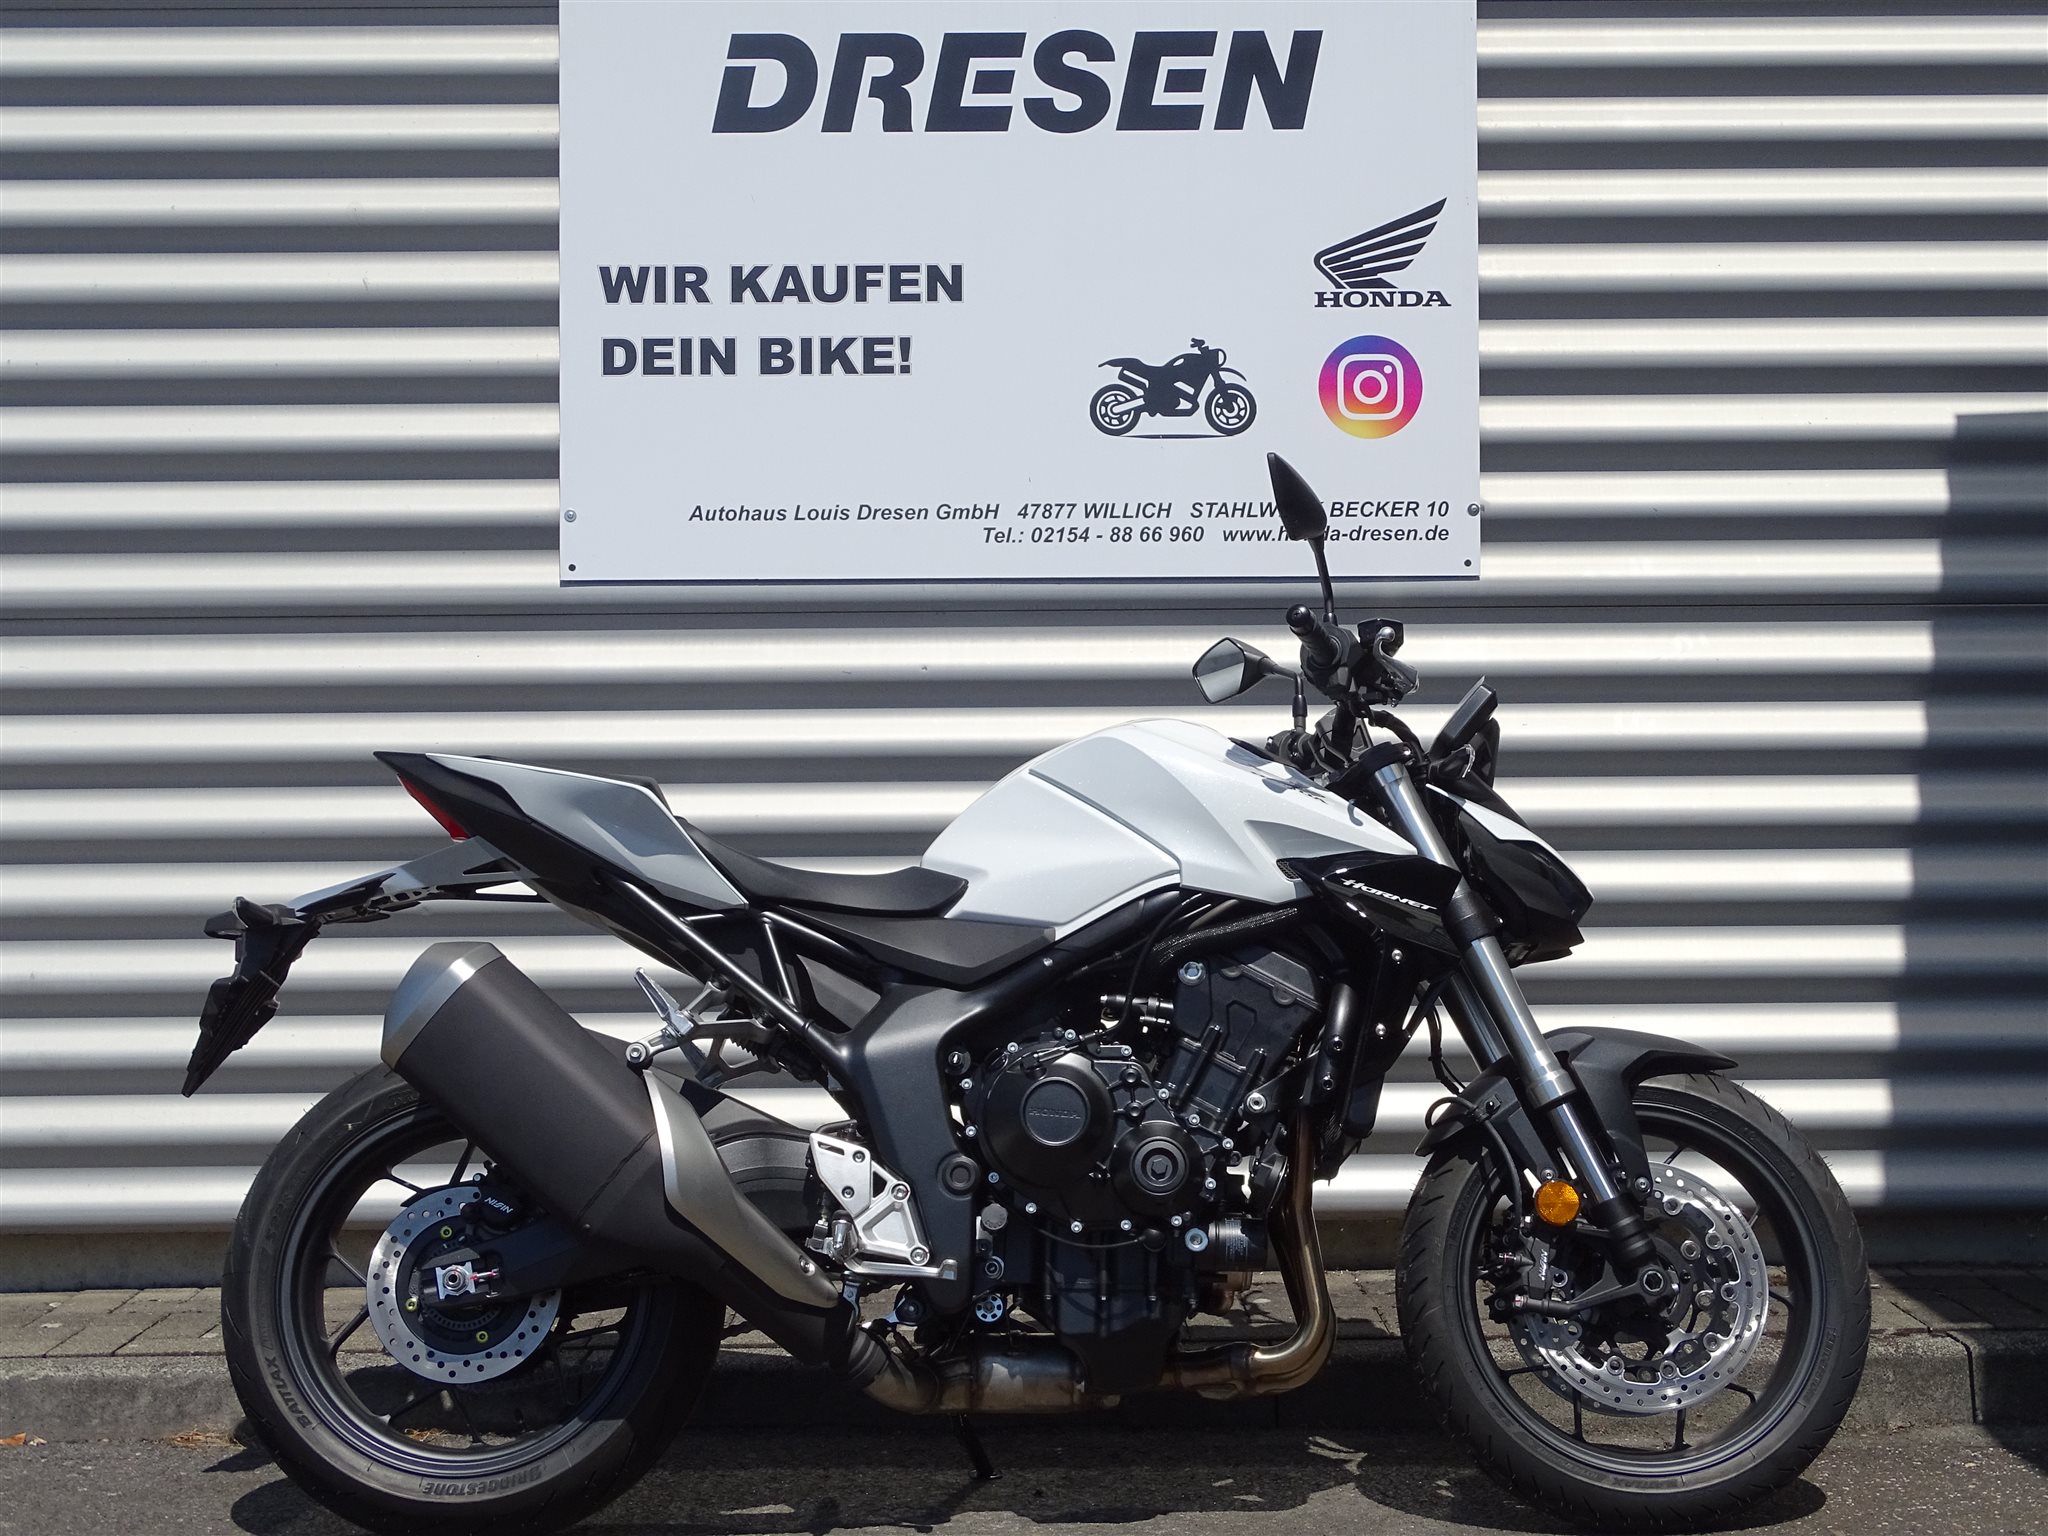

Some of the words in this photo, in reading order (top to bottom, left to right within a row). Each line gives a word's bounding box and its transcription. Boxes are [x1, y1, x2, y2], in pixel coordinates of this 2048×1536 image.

[712, 30, 1324, 134] DRESEN
[598, 265, 711, 304] WIR
[729, 264, 964, 304] KAUFEN
[1314, 290, 1452, 308] HONDA
[601, 337, 737, 376] DEIN
[759, 336, 912, 376] BIKE!
[688, 505, 788, 522] Autohaus
[793, 505, 850, 521] Louis
[856, 504, 929, 521] Dresen
[936, 503, 1000, 520] GmbH
[1017, 503, 1078, 520] 47877
[1084, 502, 1173, 519] WILLICH
[1190, 502, 1325, 518] STAHLW
[1329, 500, 1421, 517] BECKER
[1427, 500, 1450, 517] 10
[983, 526, 1025, 544] Tel.:
[1031, 526, 1090, 543] 02154
[1109, 526, 1133, 543] 88
[1139, 526, 1163, 543] 66
[1169, 525, 1205, 543] 960
[264, 1356, 313, 1428] BATTLAX
[422, 1465, 543, 1496] BRIDGESTONE
